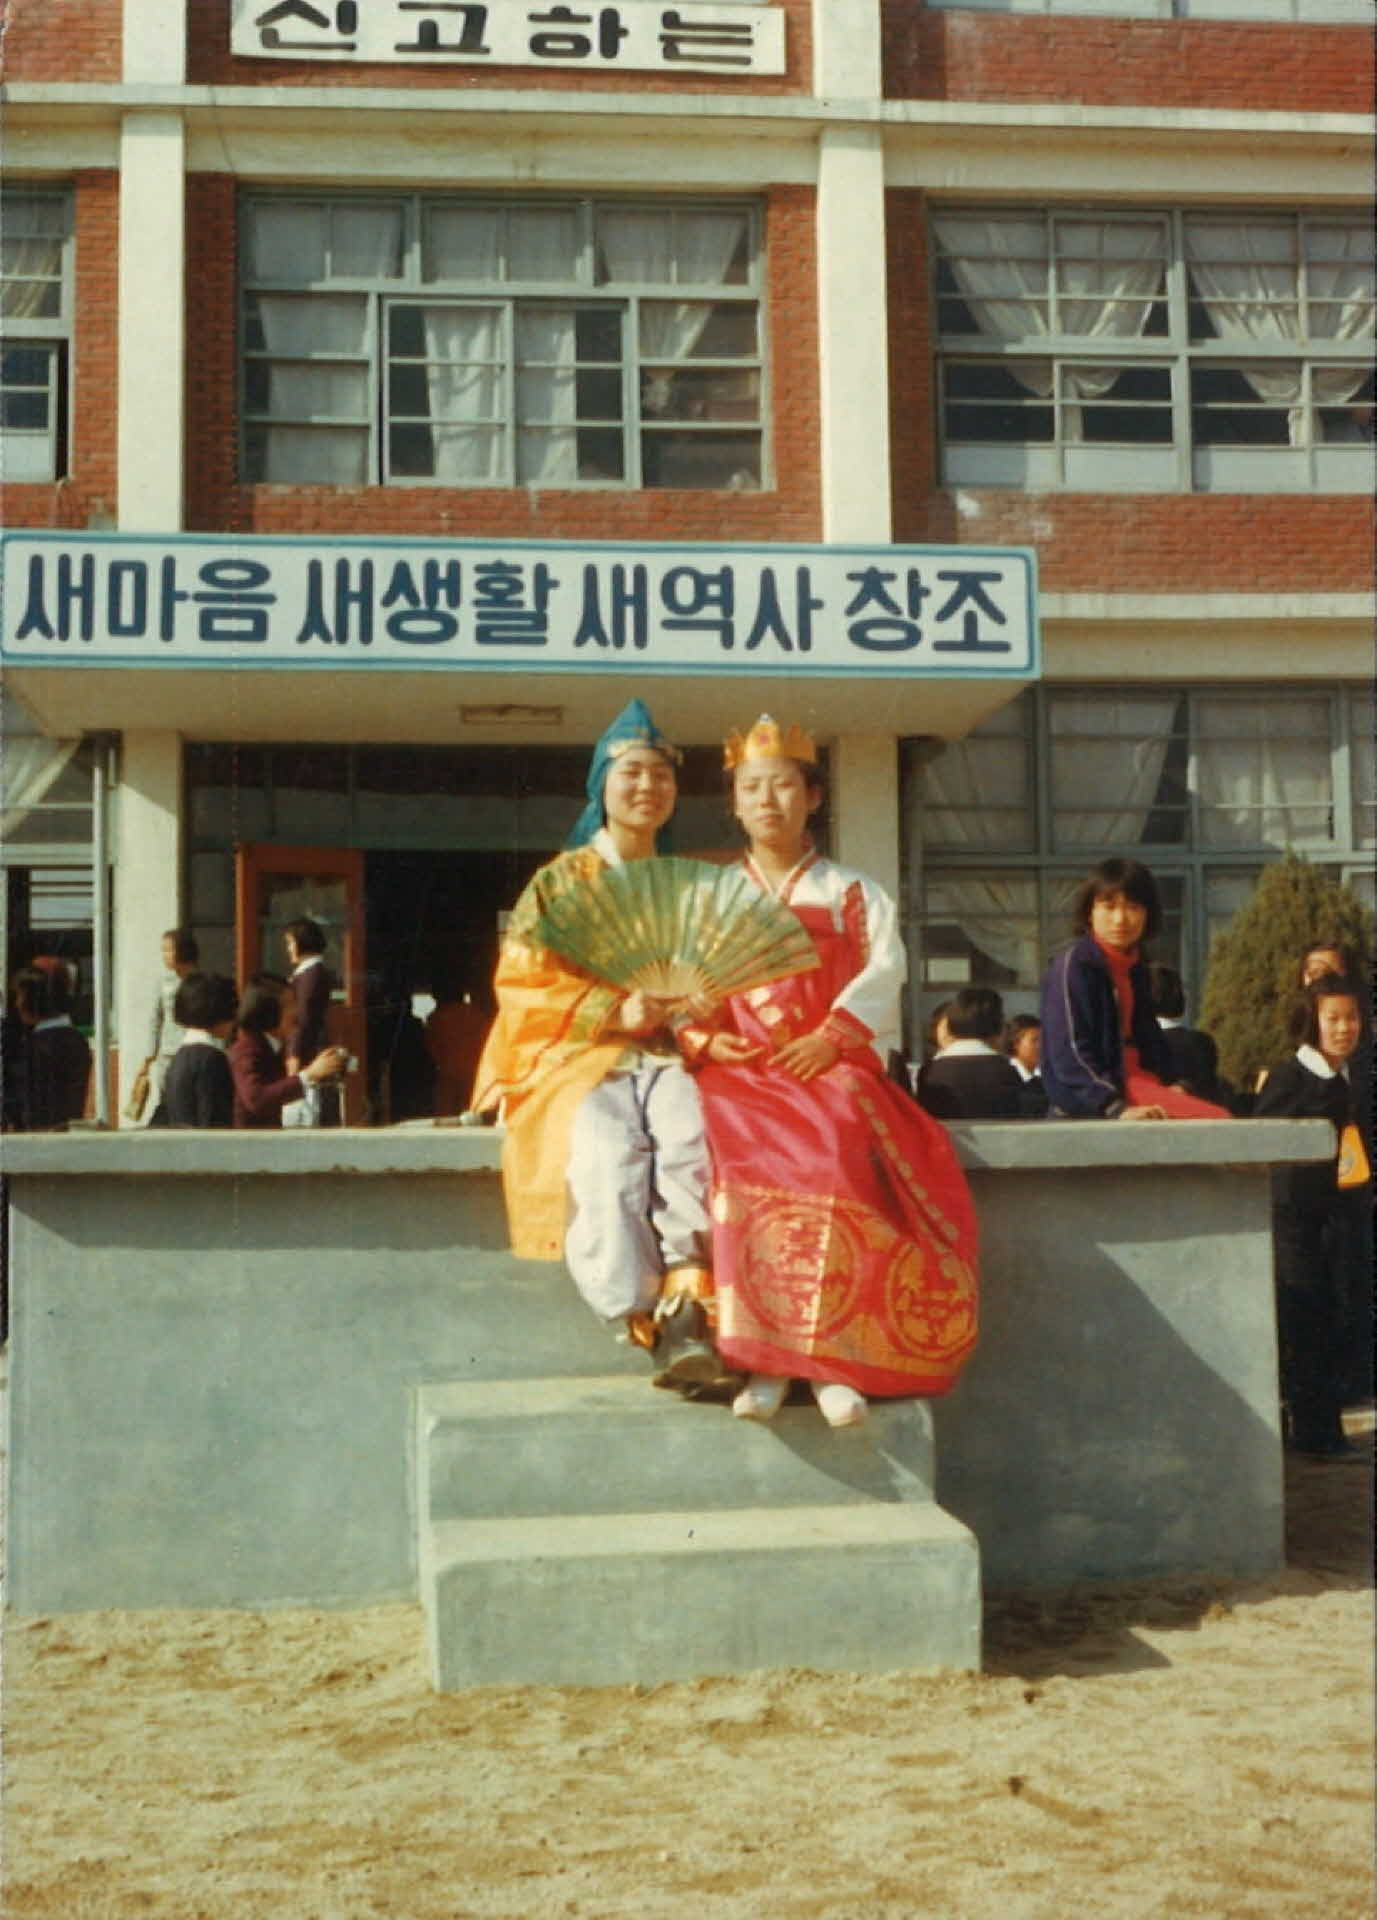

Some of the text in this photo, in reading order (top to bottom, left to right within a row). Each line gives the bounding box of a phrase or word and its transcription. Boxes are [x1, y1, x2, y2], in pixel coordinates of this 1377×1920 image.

[255, 0, 754, 65] 신고하는
[15, 553, 1012, 653] 새마음 새생활 새역사 창조
